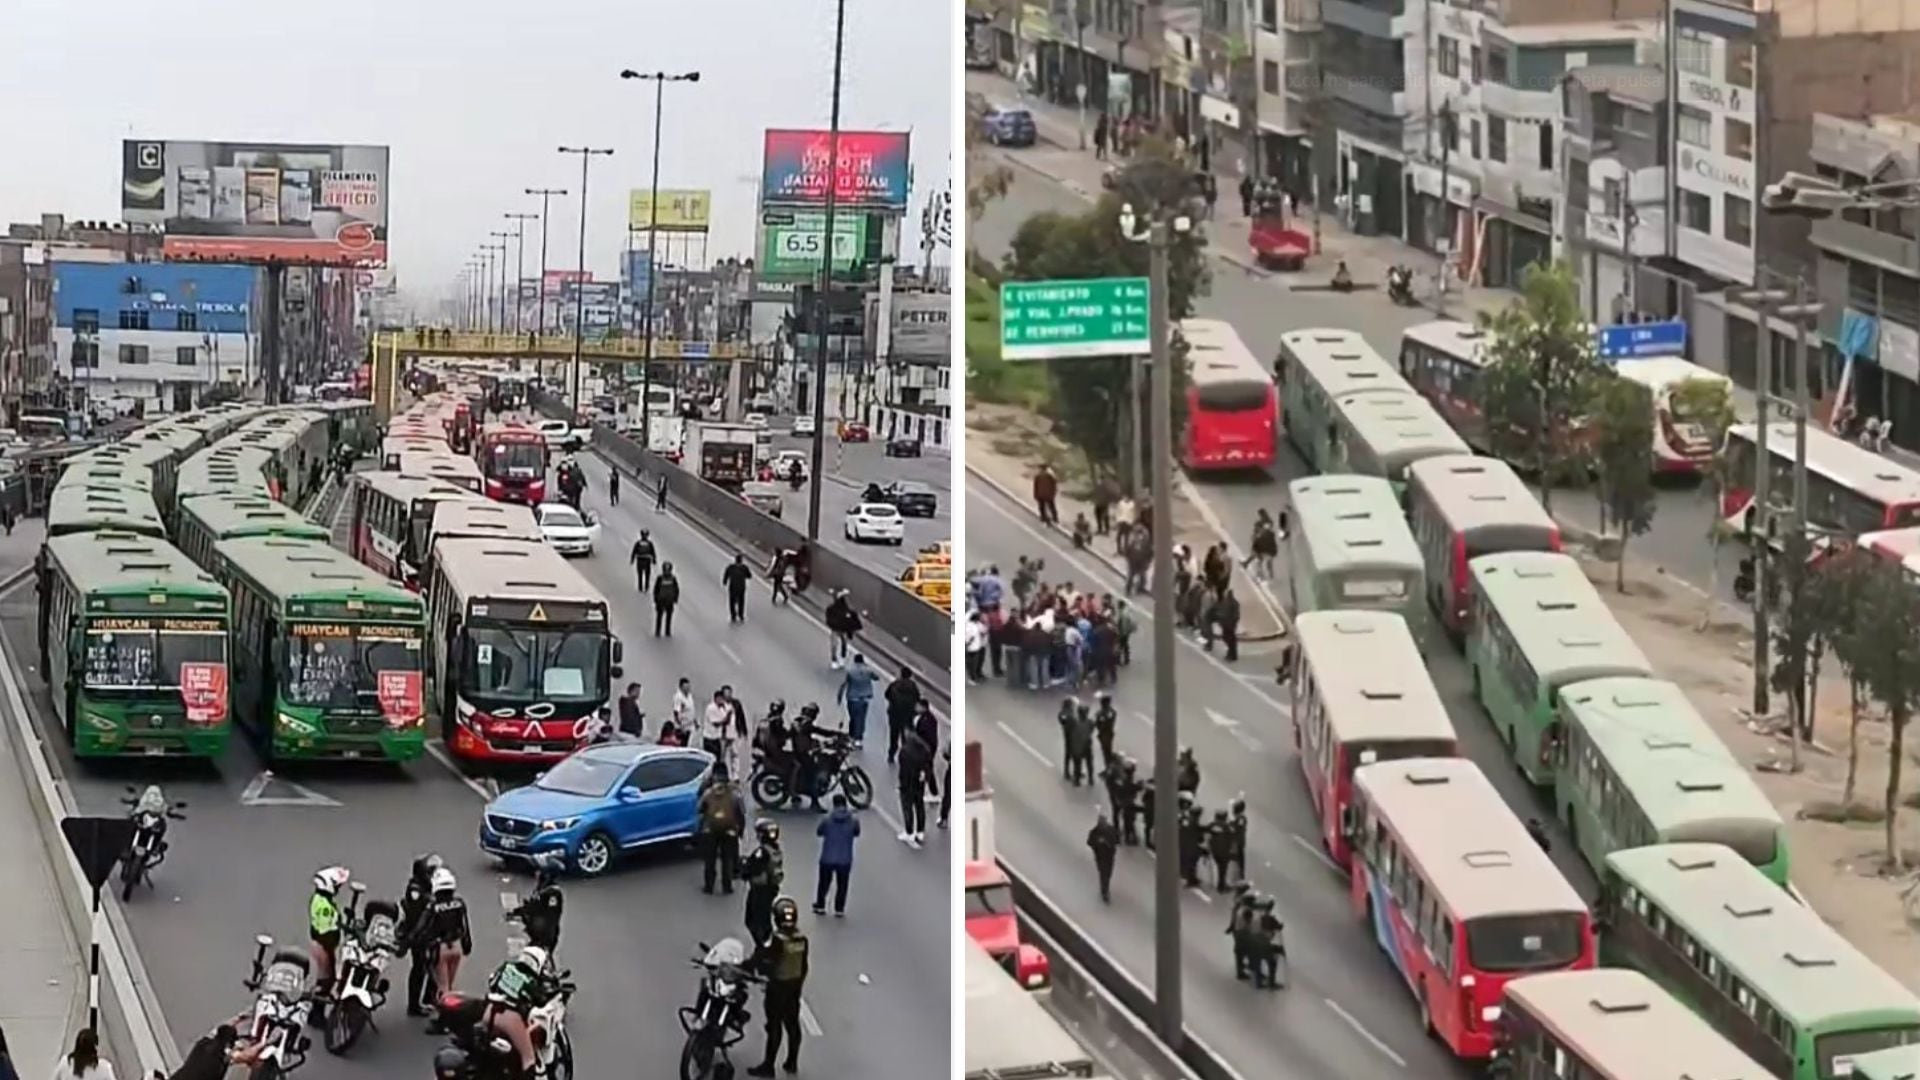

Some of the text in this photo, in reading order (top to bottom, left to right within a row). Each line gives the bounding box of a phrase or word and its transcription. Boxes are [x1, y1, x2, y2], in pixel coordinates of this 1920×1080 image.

[786, 234, 818, 252] 6.5
[900, 310, 948, 323] PETER
[92, 619, 149, 630] HUAYCAN
[292, 624, 350, 637] HUAYCAN
